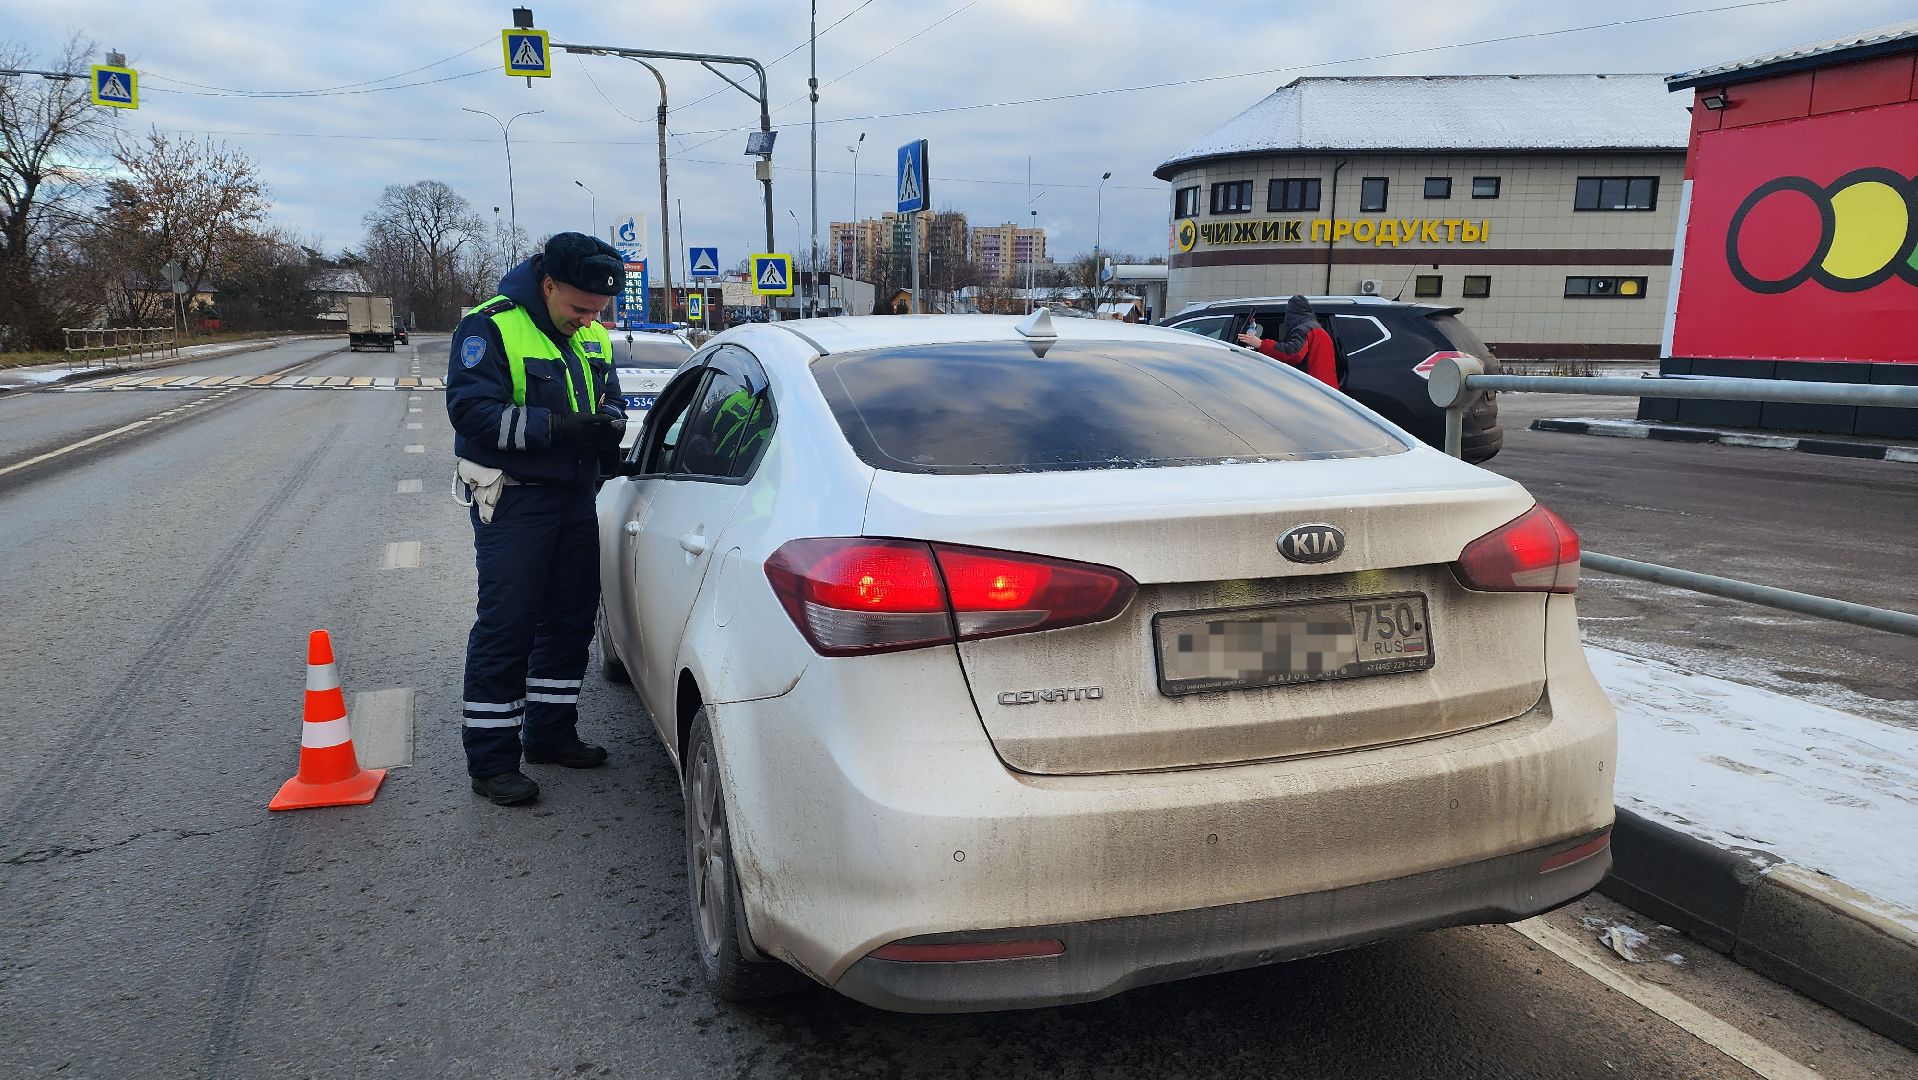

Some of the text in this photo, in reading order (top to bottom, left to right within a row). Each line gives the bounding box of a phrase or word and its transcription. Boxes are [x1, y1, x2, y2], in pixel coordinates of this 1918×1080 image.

[1200, 220, 1303, 244] ЧИЖИК
[1311, 219, 1489, 247] ПРОДУКТЫ
[1291, 531, 1338, 556] KIA
[1355, 601, 1414, 641] 750
[1374, 640, 1403, 655] RUS
[997, 686, 1104, 705] CERATO
